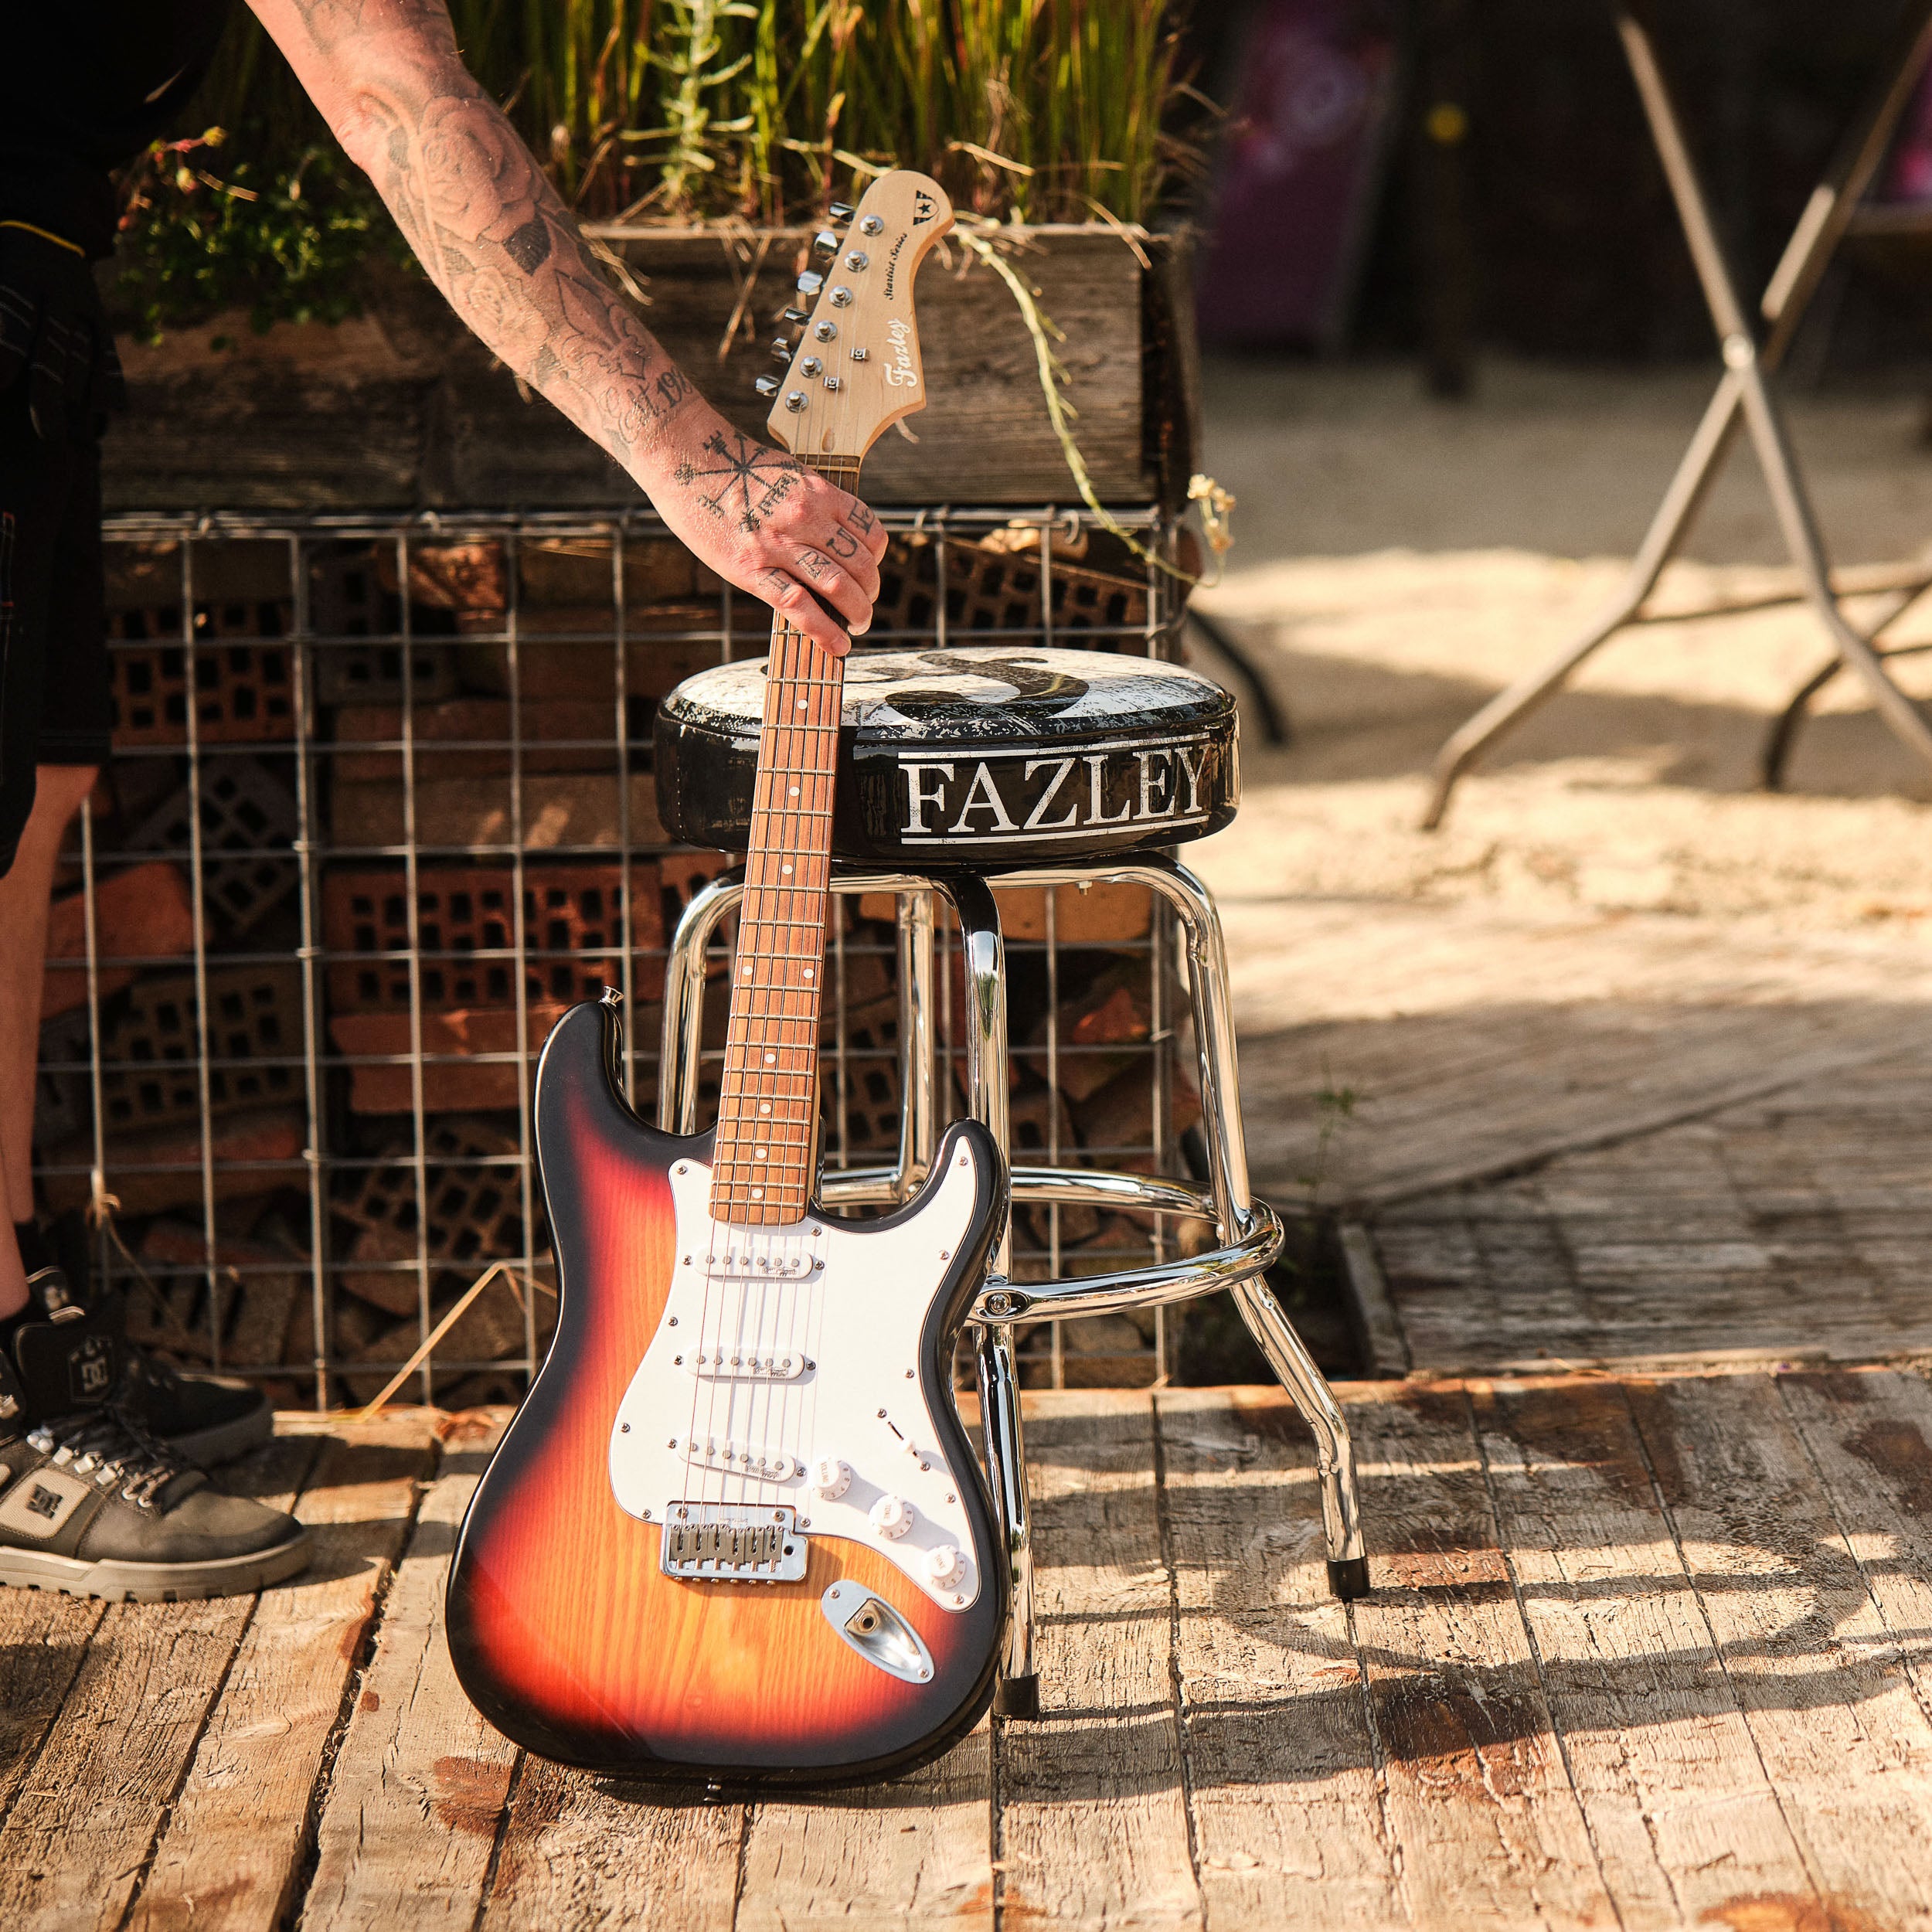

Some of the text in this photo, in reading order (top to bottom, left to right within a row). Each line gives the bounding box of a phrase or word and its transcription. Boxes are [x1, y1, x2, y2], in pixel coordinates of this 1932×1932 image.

[889, 233, 907, 260] Series
[883, 318, 917, 387] Fazley
[897, 743, 1211, 833] FAZLEY
